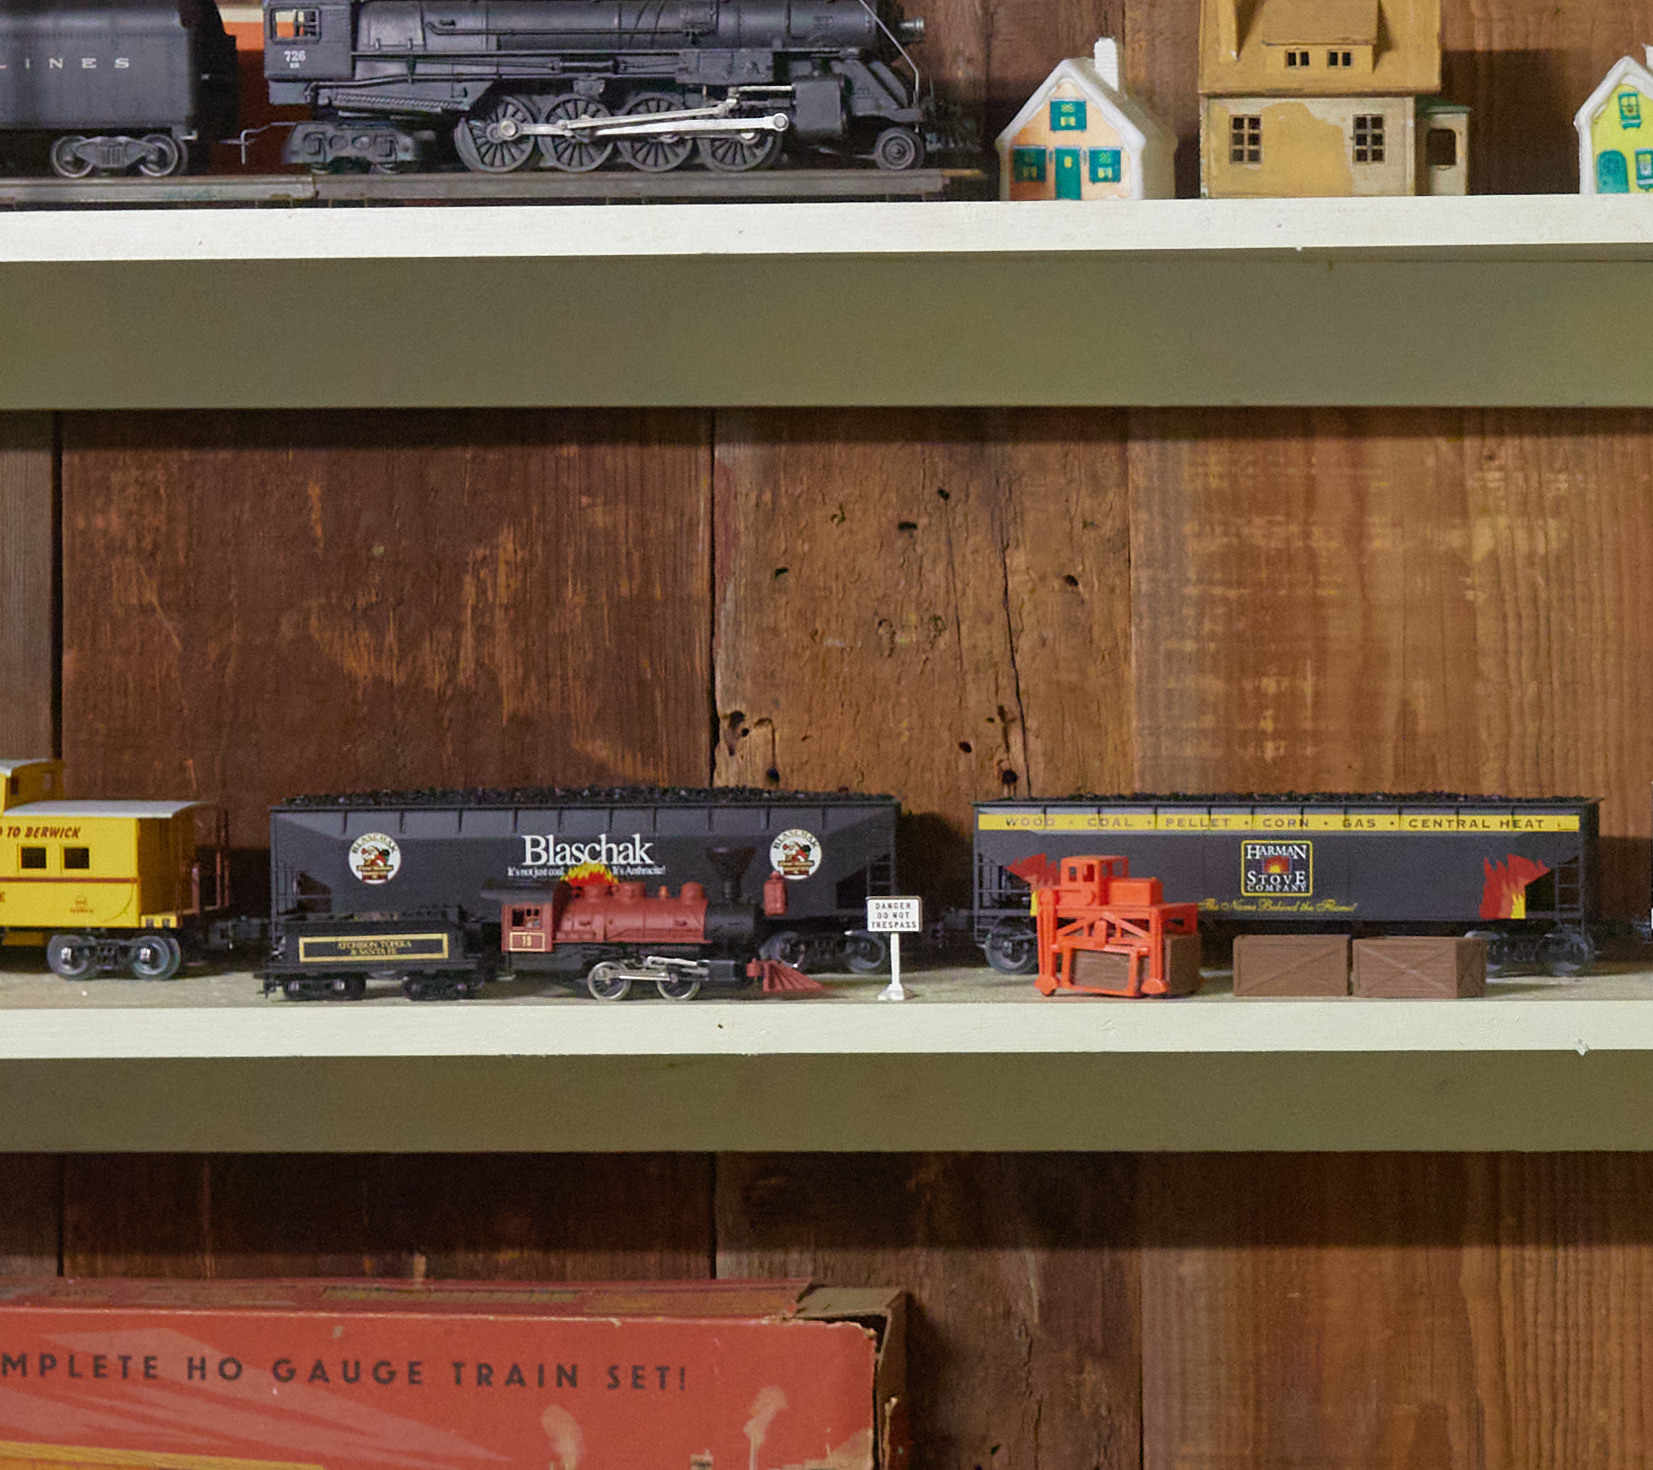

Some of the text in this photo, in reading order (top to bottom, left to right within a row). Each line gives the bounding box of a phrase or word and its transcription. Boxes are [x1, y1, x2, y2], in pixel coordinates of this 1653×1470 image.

[1005, 816, 1546, 830] WOOD COAL PELLET CORN GAS CENTRAL HEAT
[6, 826, 21, 839] TO
[25, 826, 81, 839] BERWICK
[521, 833, 655, 867] Blaschak
[1246, 844, 1307, 860] HARMAN
[1247, 870, 1306, 886] STOVE
[1247, 884, 1307, 892] COMPANY
[875, 902, 911, 910] DANGER
[877, 912, 911, 920] DO NOT
[871, 921, 917, 930] TRESPASS
[187, 1355, 244, 1383] HO
[272, 1357, 425, 1388] GAUGE
[452, 1361, 580, 1391] TRAIN
[608, 1363, 687, 1392] SET!
